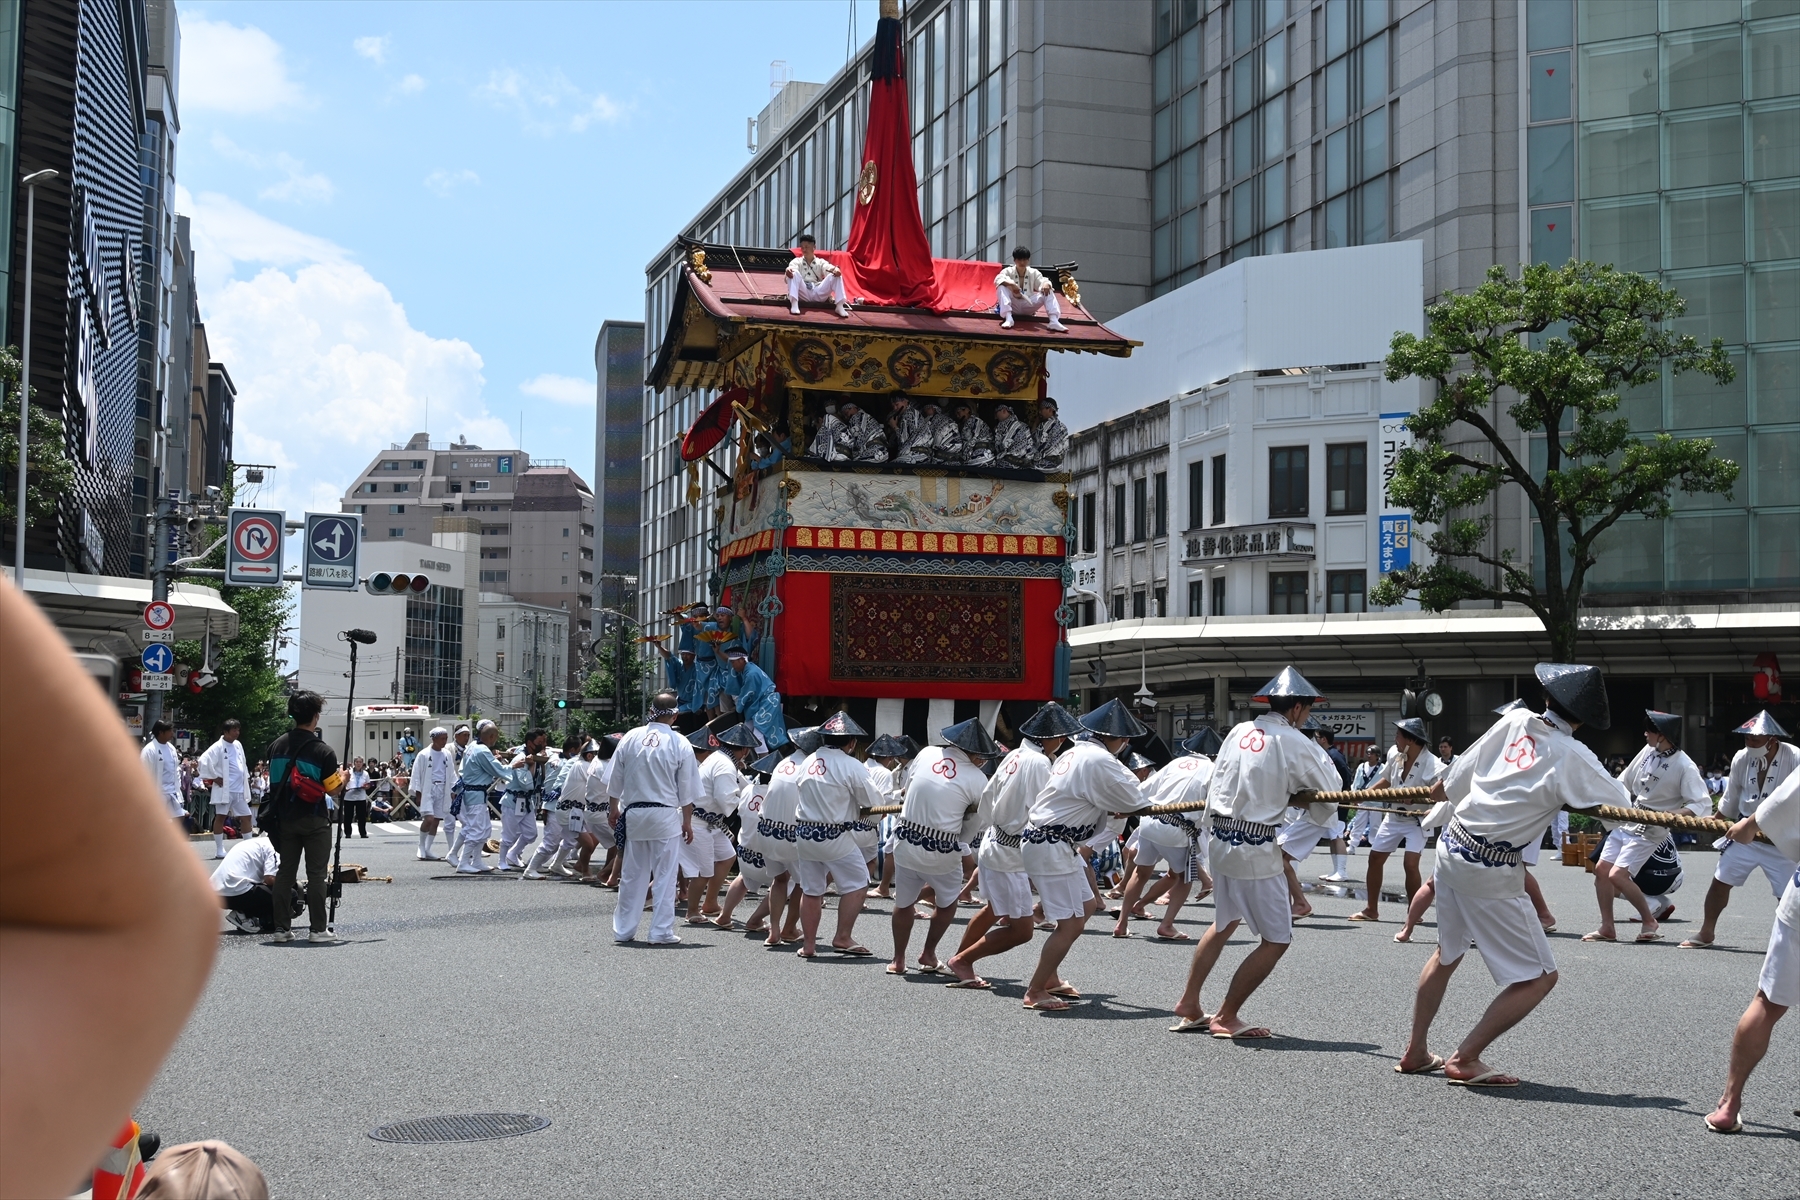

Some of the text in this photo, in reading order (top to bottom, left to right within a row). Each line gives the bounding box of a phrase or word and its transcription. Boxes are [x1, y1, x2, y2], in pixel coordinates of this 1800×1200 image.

[1382, 520, 1394, 571] 買えます
[1395, 520, 1408, 548] すぐ
[308, 567, 353, 580] 路線バスを除く
